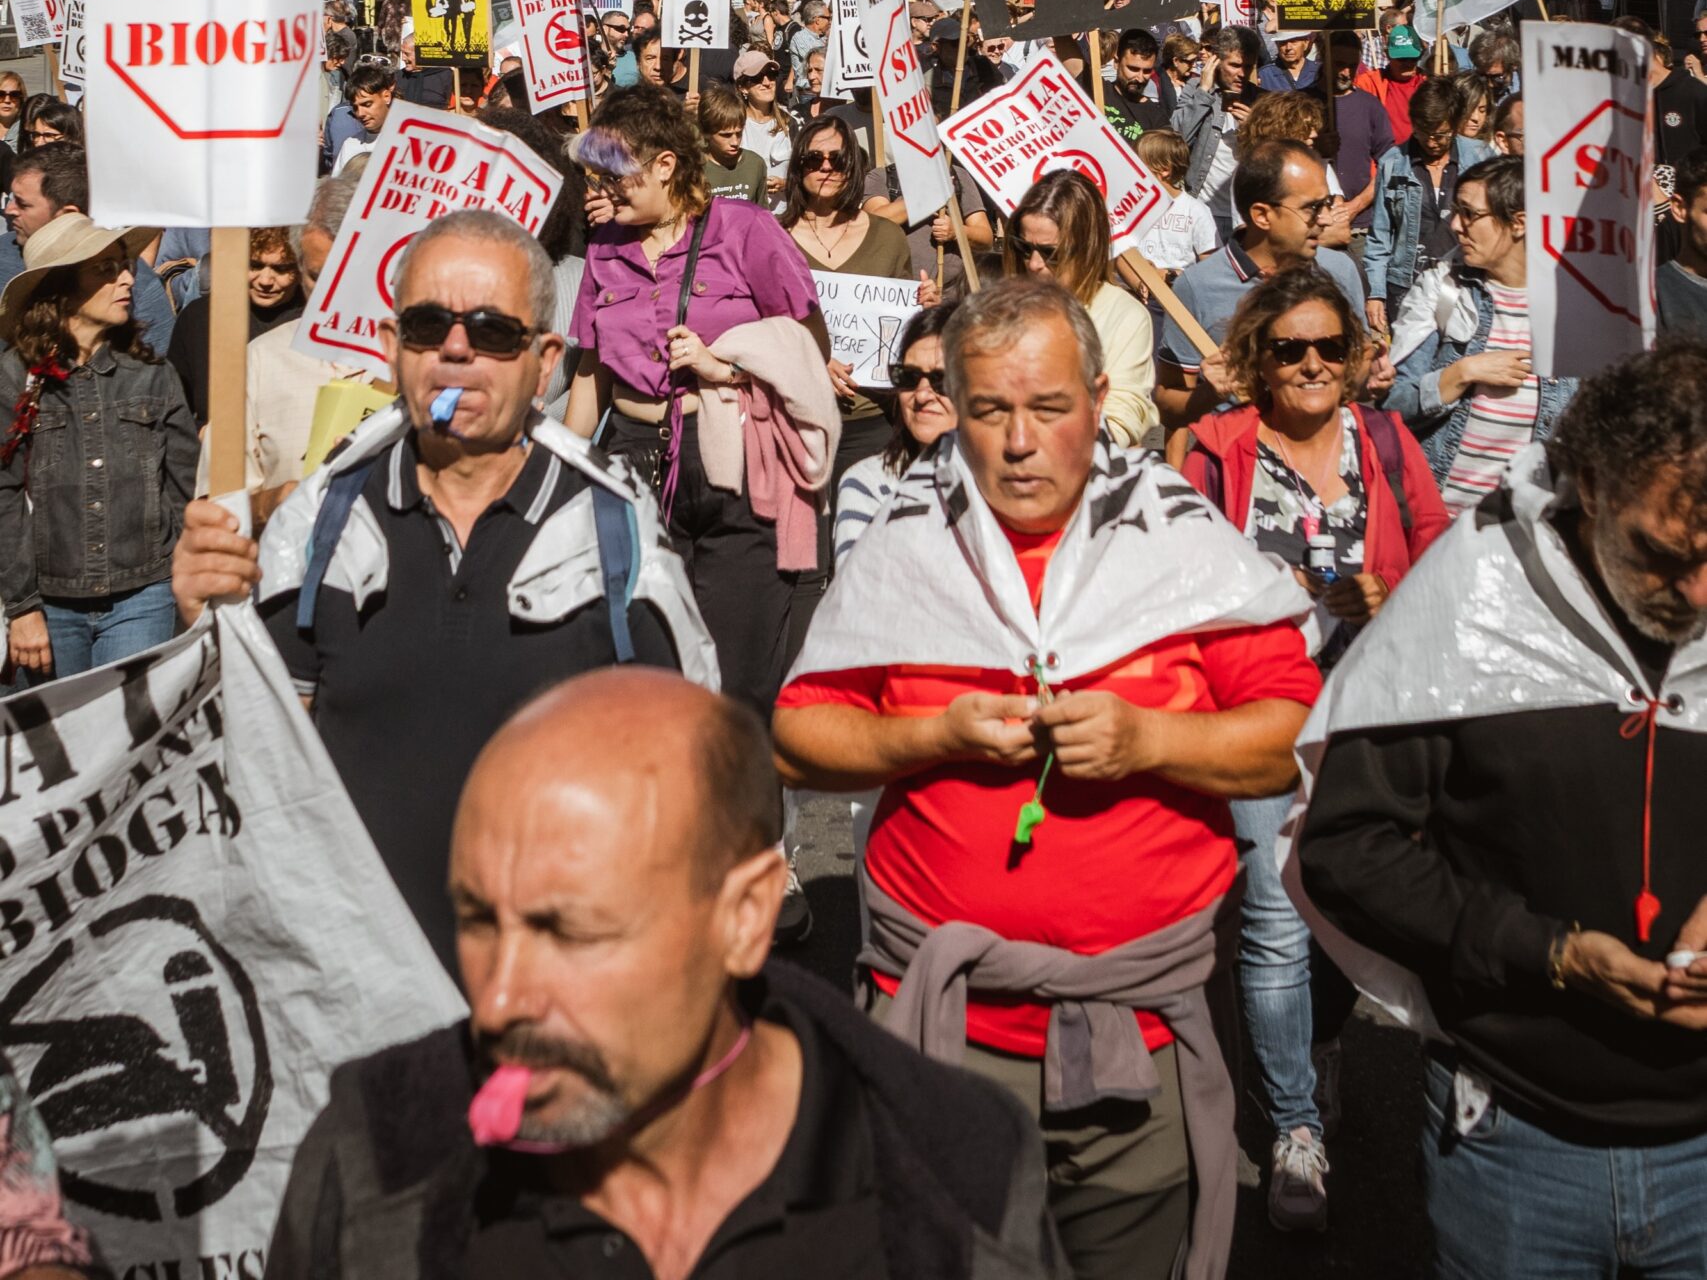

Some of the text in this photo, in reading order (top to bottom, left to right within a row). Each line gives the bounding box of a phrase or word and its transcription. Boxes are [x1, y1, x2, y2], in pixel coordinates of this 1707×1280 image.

[525, 0, 546, 17] DE
[843, 8, 857, 18] DE
[126, 12, 309, 67] BIOGAS
[538, 78, 546, 92] A
[845, 65, 852, 74] A
[961, 75, 1062, 153] NO A LA
[977, 93, 1071, 165] MACRO PLANTA
[988, 105, 1083, 179] DE BIOGAS
[389, 169, 459, 202] MACRO
[397, 136, 535, 225] NO A LA
[380, 188, 421, 215] DE
[1107, 182, 1149, 229] ESOLA
[324, 311, 340, 330] A
[829, 333, 868, 354] EGRE
[33, 690, 225, 859] PLANT
